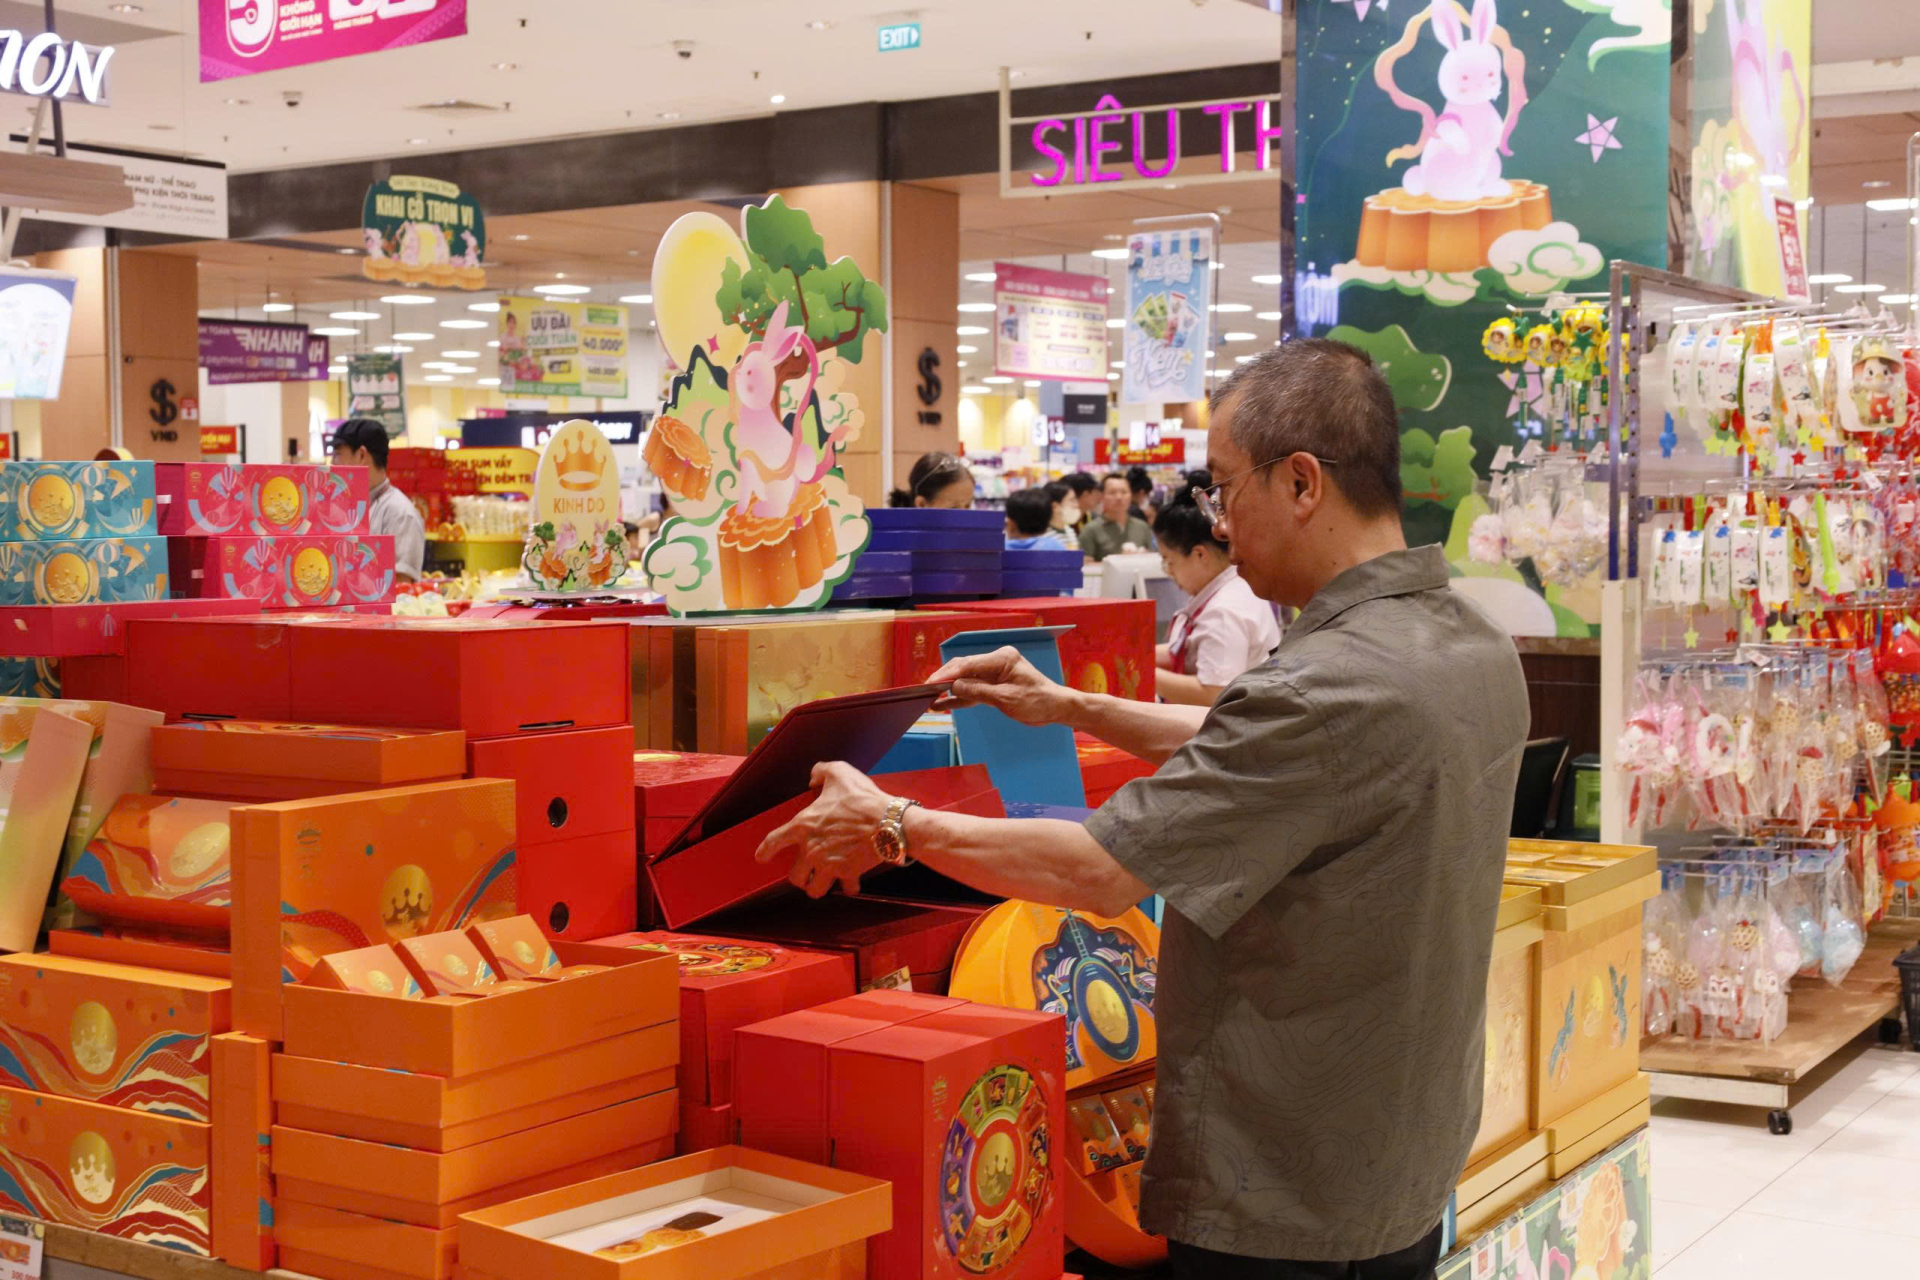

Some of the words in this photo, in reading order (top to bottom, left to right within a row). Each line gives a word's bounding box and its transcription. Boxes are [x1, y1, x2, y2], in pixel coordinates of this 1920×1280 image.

[880, 27, 910, 49] EXIT
[1031, 95, 1181, 187] SIÊU
[375, 194, 405, 218] KHAI
[426, 200, 458, 228] TRỌN
[461, 205, 474, 230] VỊ
[240, 327, 304, 354] NHANH
[553, 497, 584, 514] KINH
